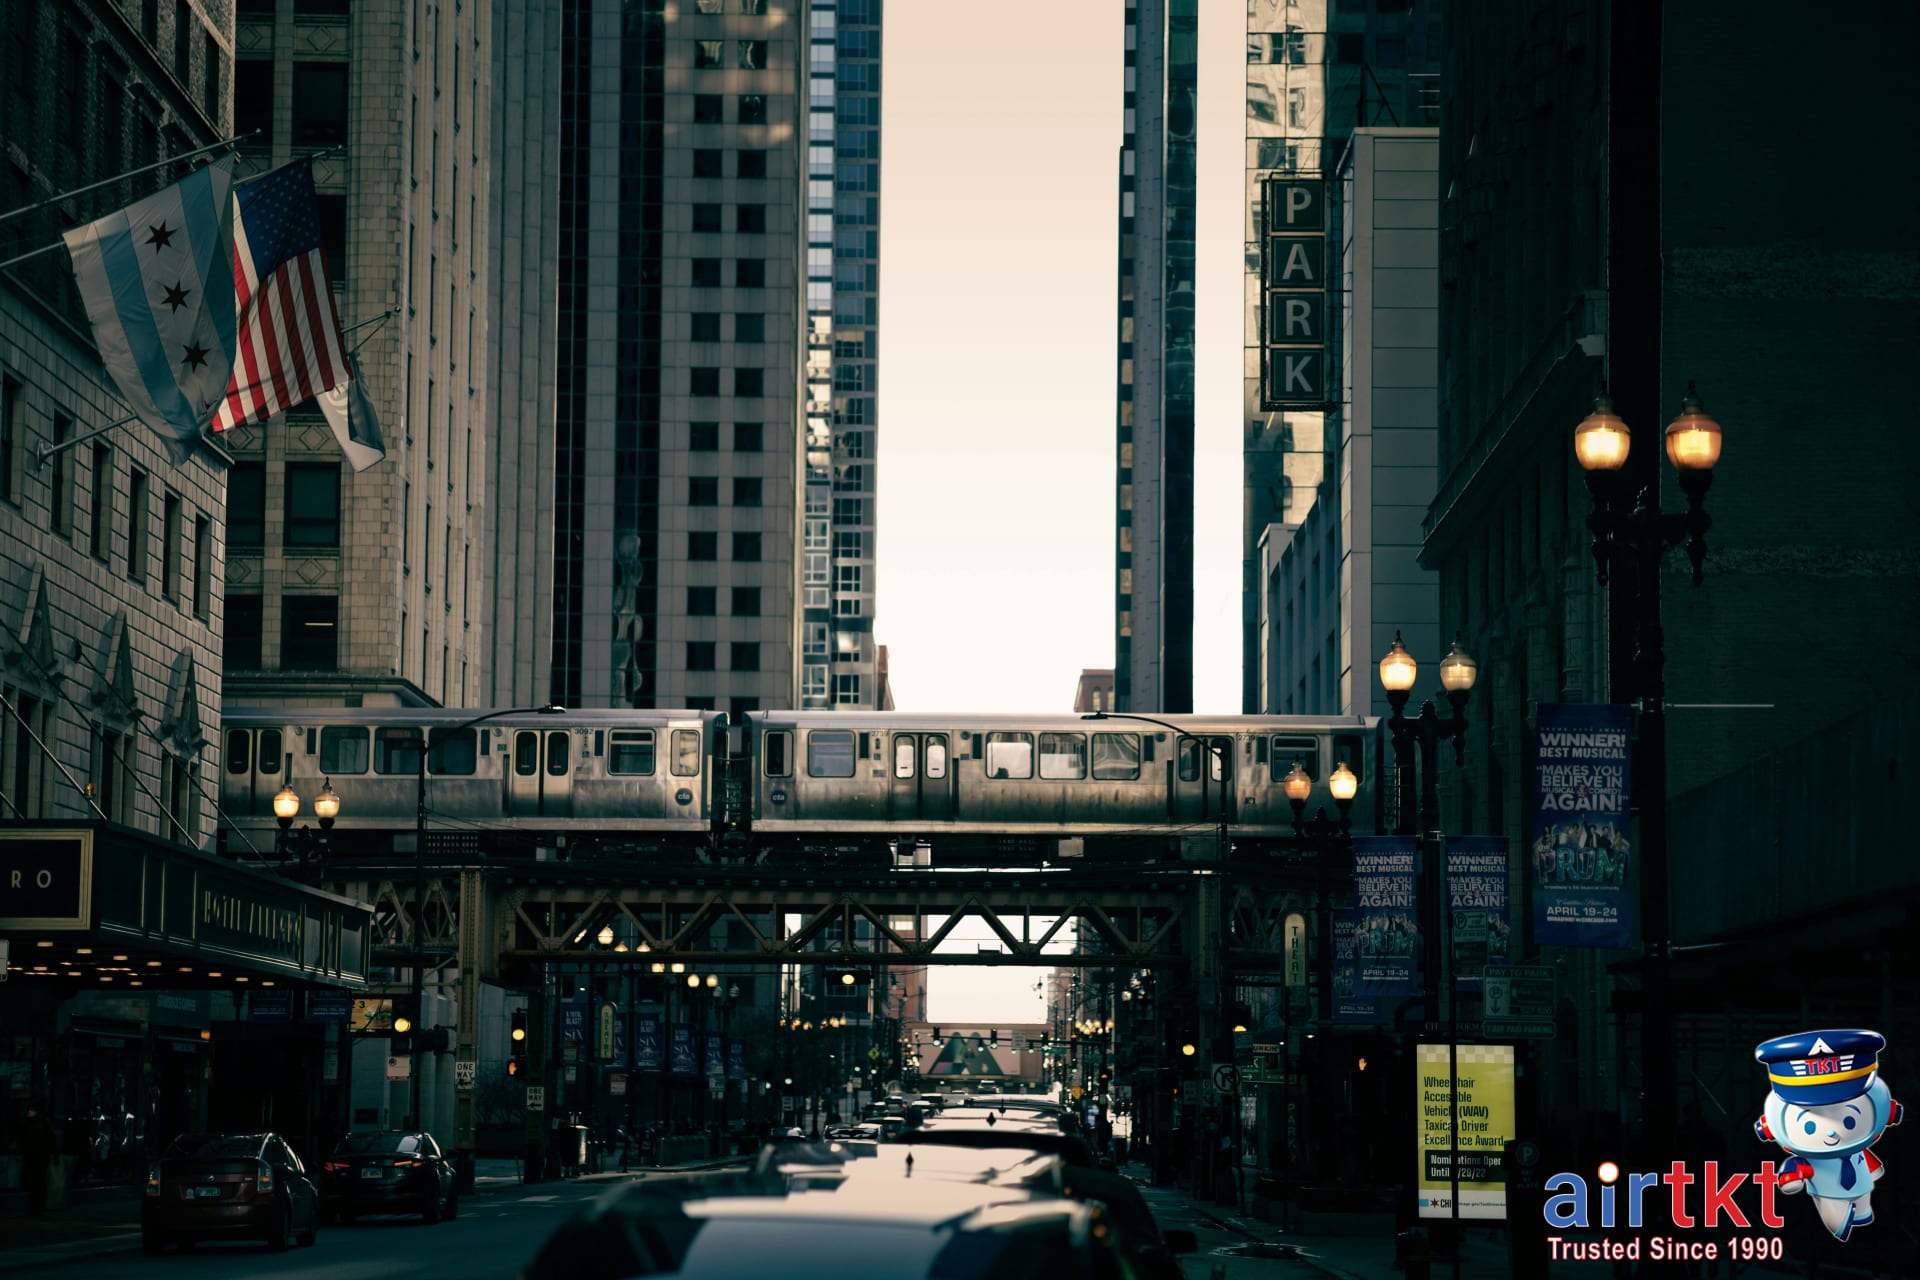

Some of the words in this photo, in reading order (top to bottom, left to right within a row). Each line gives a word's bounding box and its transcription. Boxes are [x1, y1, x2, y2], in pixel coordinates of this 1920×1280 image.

[1282, 187, 1314, 393] PARK
[1540, 733, 1626, 747] WINNER!
[1540, 748, 1570, 758] BEST
[1572, 748, 1626, 759] MUSICAL
[1593, 765, 1622, 776] YOU
[1542, 776, 1603, 787] BELIEVE
[1606, 776, 1622, 788] IN
[1356, 855, 1414, 864] WINNER!
[1448, 855, 1506, 864] WINNER!
[1538, 848, 1626, 884] PROM
[1392, 876, 1412, 884] YOU
[1484, 876, 1504, 884] YOU
[1358, 884, 1400, 892] BELIEVE
[1402, 884, 1412, 892] IN
[1450, 884, 1492, 892] BELIEVE
[1494, 884, 1504, 892] IN
[1546, 906, 1580, 916] APRIL
[1358, 929, 1414, 954] PROM
[564, 1029, 584, 1040] SIX
[1424, 1076, 1476, 1088] Wheehair
[1424, 1106, 1452, 1116] Vehicl
[1458, 1106, 1488, 1120] (WAV)
[1462, 1120, 1488, 1132] Driver
[1476, 1134, 1504, 1146] Award
[1430, 1167, 1450, 1177] Until
